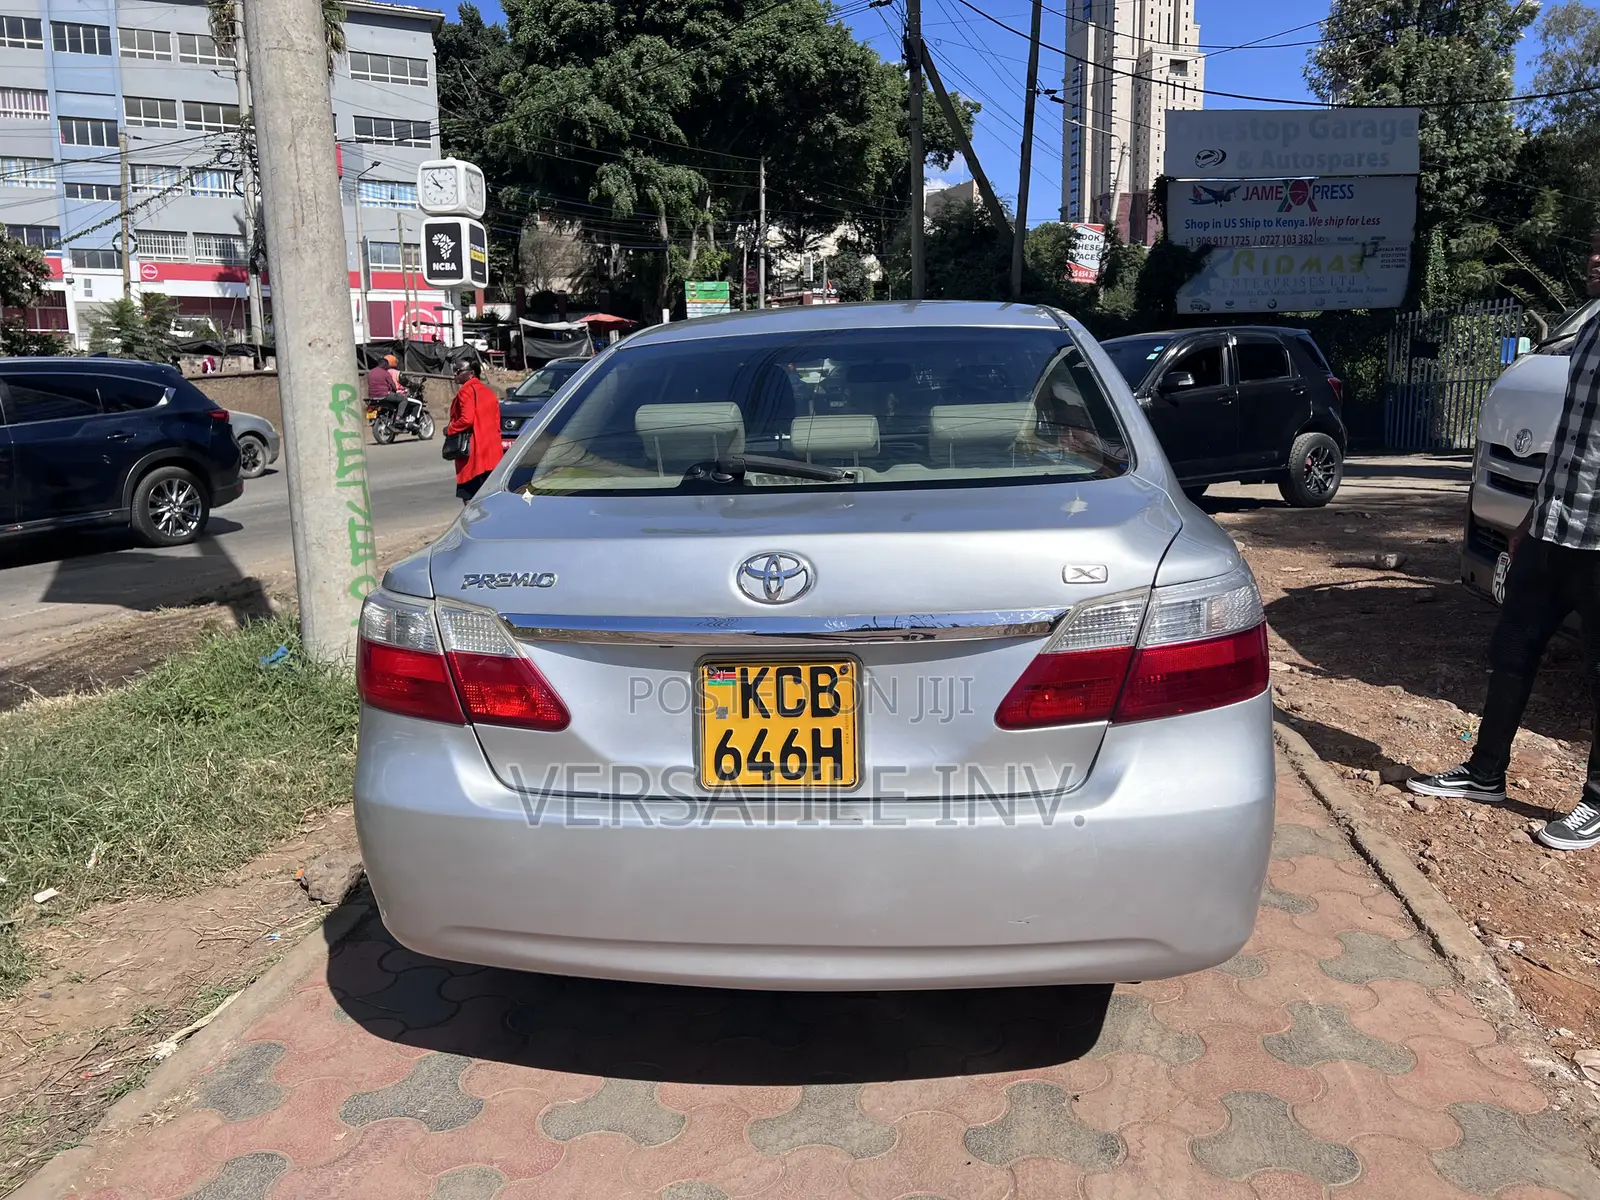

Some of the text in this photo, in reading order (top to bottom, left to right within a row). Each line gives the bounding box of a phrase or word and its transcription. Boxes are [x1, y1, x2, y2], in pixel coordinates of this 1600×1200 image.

[1308, 113, 1416, 146] Garage
[1260, 149, 1391, 172] Autospares
[1184, 218, 1210, 231] Shop
[1212, 218, 1222, 229] in
[1223, 218, 1237, 229] US
[1238, 217, 1261, 230] Ship
[1263, 218, 1273, 228] to
[1324, 215, 1344, 228] ship
[1345, 215, 1360, 226] for
[1361, 215, 1381, 226] Less
[1081, 233, 1100, 241] OOK
[1213, 235, 1228, 245] 917
[1230, 235, 1250, 245] 1725
[1259, 234, 1280, 245] 0727
[1282, 234, 1297, 245] 103
[1299, 233, 1314, 244] 382
[1077, 243, 1101, 251] HESE
[1075, 252, 1101, 261] PACES
[432, 262, 457, 271] NCBA
[1222, 276, 1325, 288] ENTERPRISES
[460, 572, 556, 590] PREMIO
[740, 666, 842, 719] KCB
[714, 727, 843, 780] 646H
